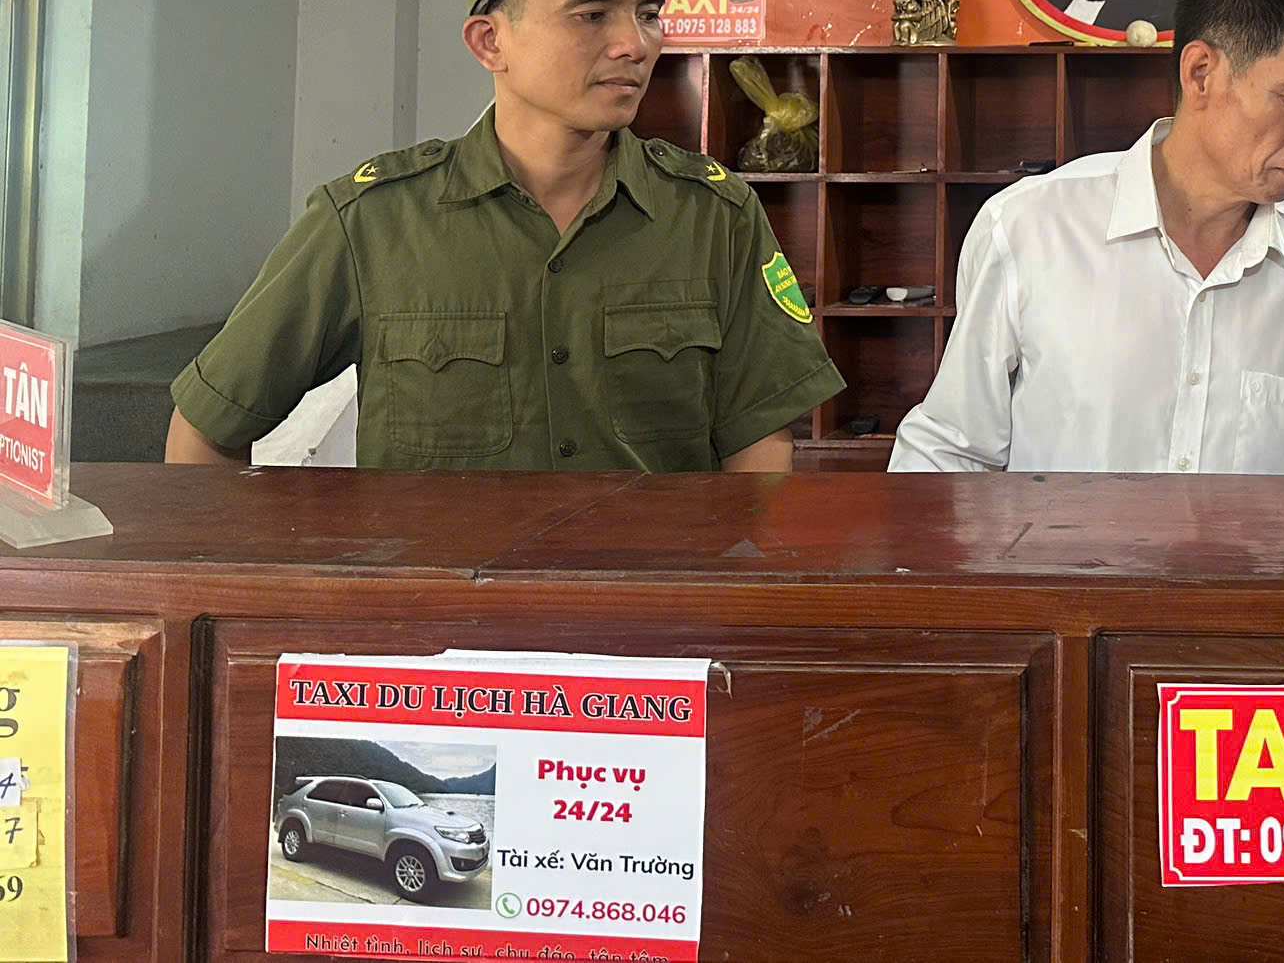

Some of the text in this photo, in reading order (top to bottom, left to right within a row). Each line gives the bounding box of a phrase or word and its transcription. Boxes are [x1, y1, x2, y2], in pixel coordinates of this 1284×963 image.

[659, 19, 756, 33] T: 0975 128 883
[3, 362, 48, 428] TÂN
[292, 680, 692, 722] TAXI DU LỊCH HÀ GIANG
[538, 759, 646, 791] Phục vụ
[553, 799, 633, 823] 24/24
[5, 817, 23, 844] 7
[1180, 818, 1250, 864] ĐT:
[497, 849, 695, 880] Tài xế: Văn Trường
[526, 898, 686, 924] 0974.868.046
[366, 934, 410, 955] tình,
